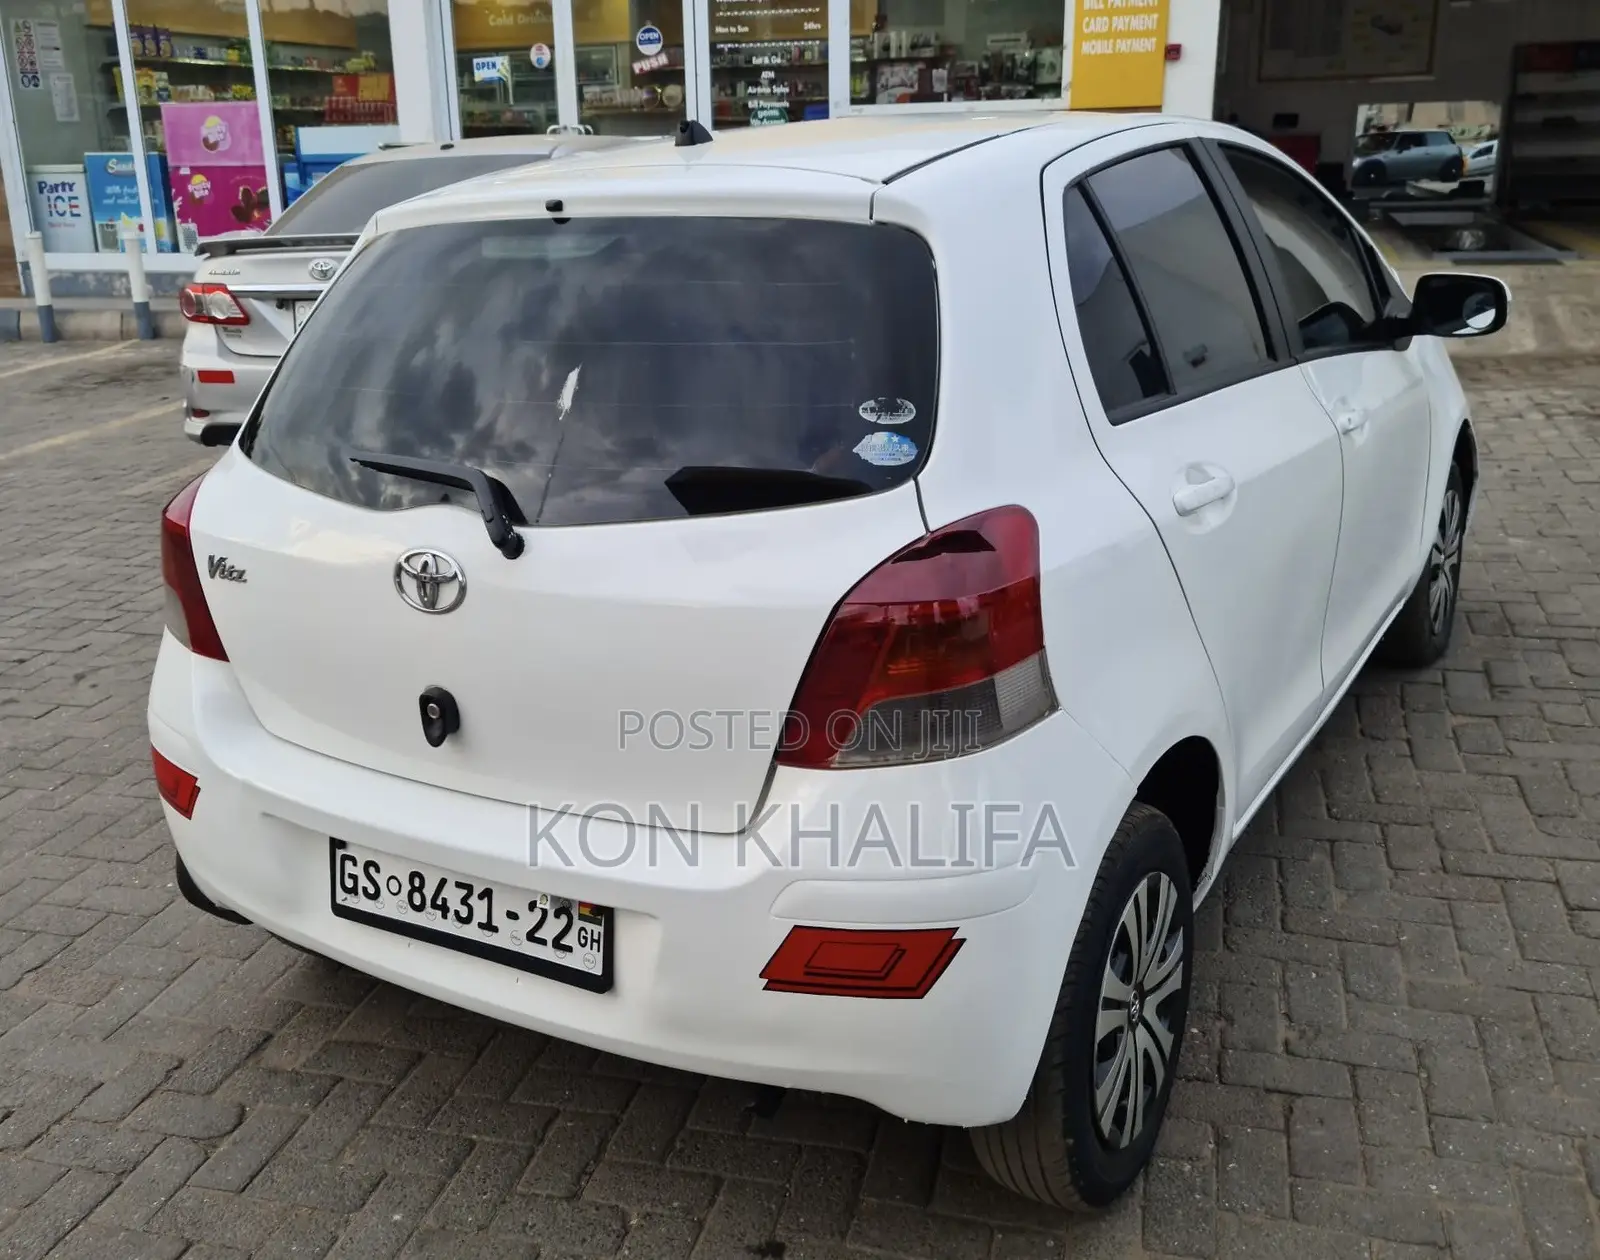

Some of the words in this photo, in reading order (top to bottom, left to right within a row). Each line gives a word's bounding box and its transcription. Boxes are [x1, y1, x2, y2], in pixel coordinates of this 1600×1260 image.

[1083, 16, 1109, 33] CARD
[1112, 14, 1158, 32] PAYMENT
[640, 32, 658, 41] OPEN
[1081, 39, 1113, 55] MOBILE
[1115, 37, 1157, 53] PAYMENT
[475, 61, 497, 71] OPEN
[632, 52, 668, 74] PUSH
[37, 181, 76, 194] Party
[47, 196, 81, 218] ICE
[339, 854, 381, 901] GS
[577, 926, 601, 953] GH
